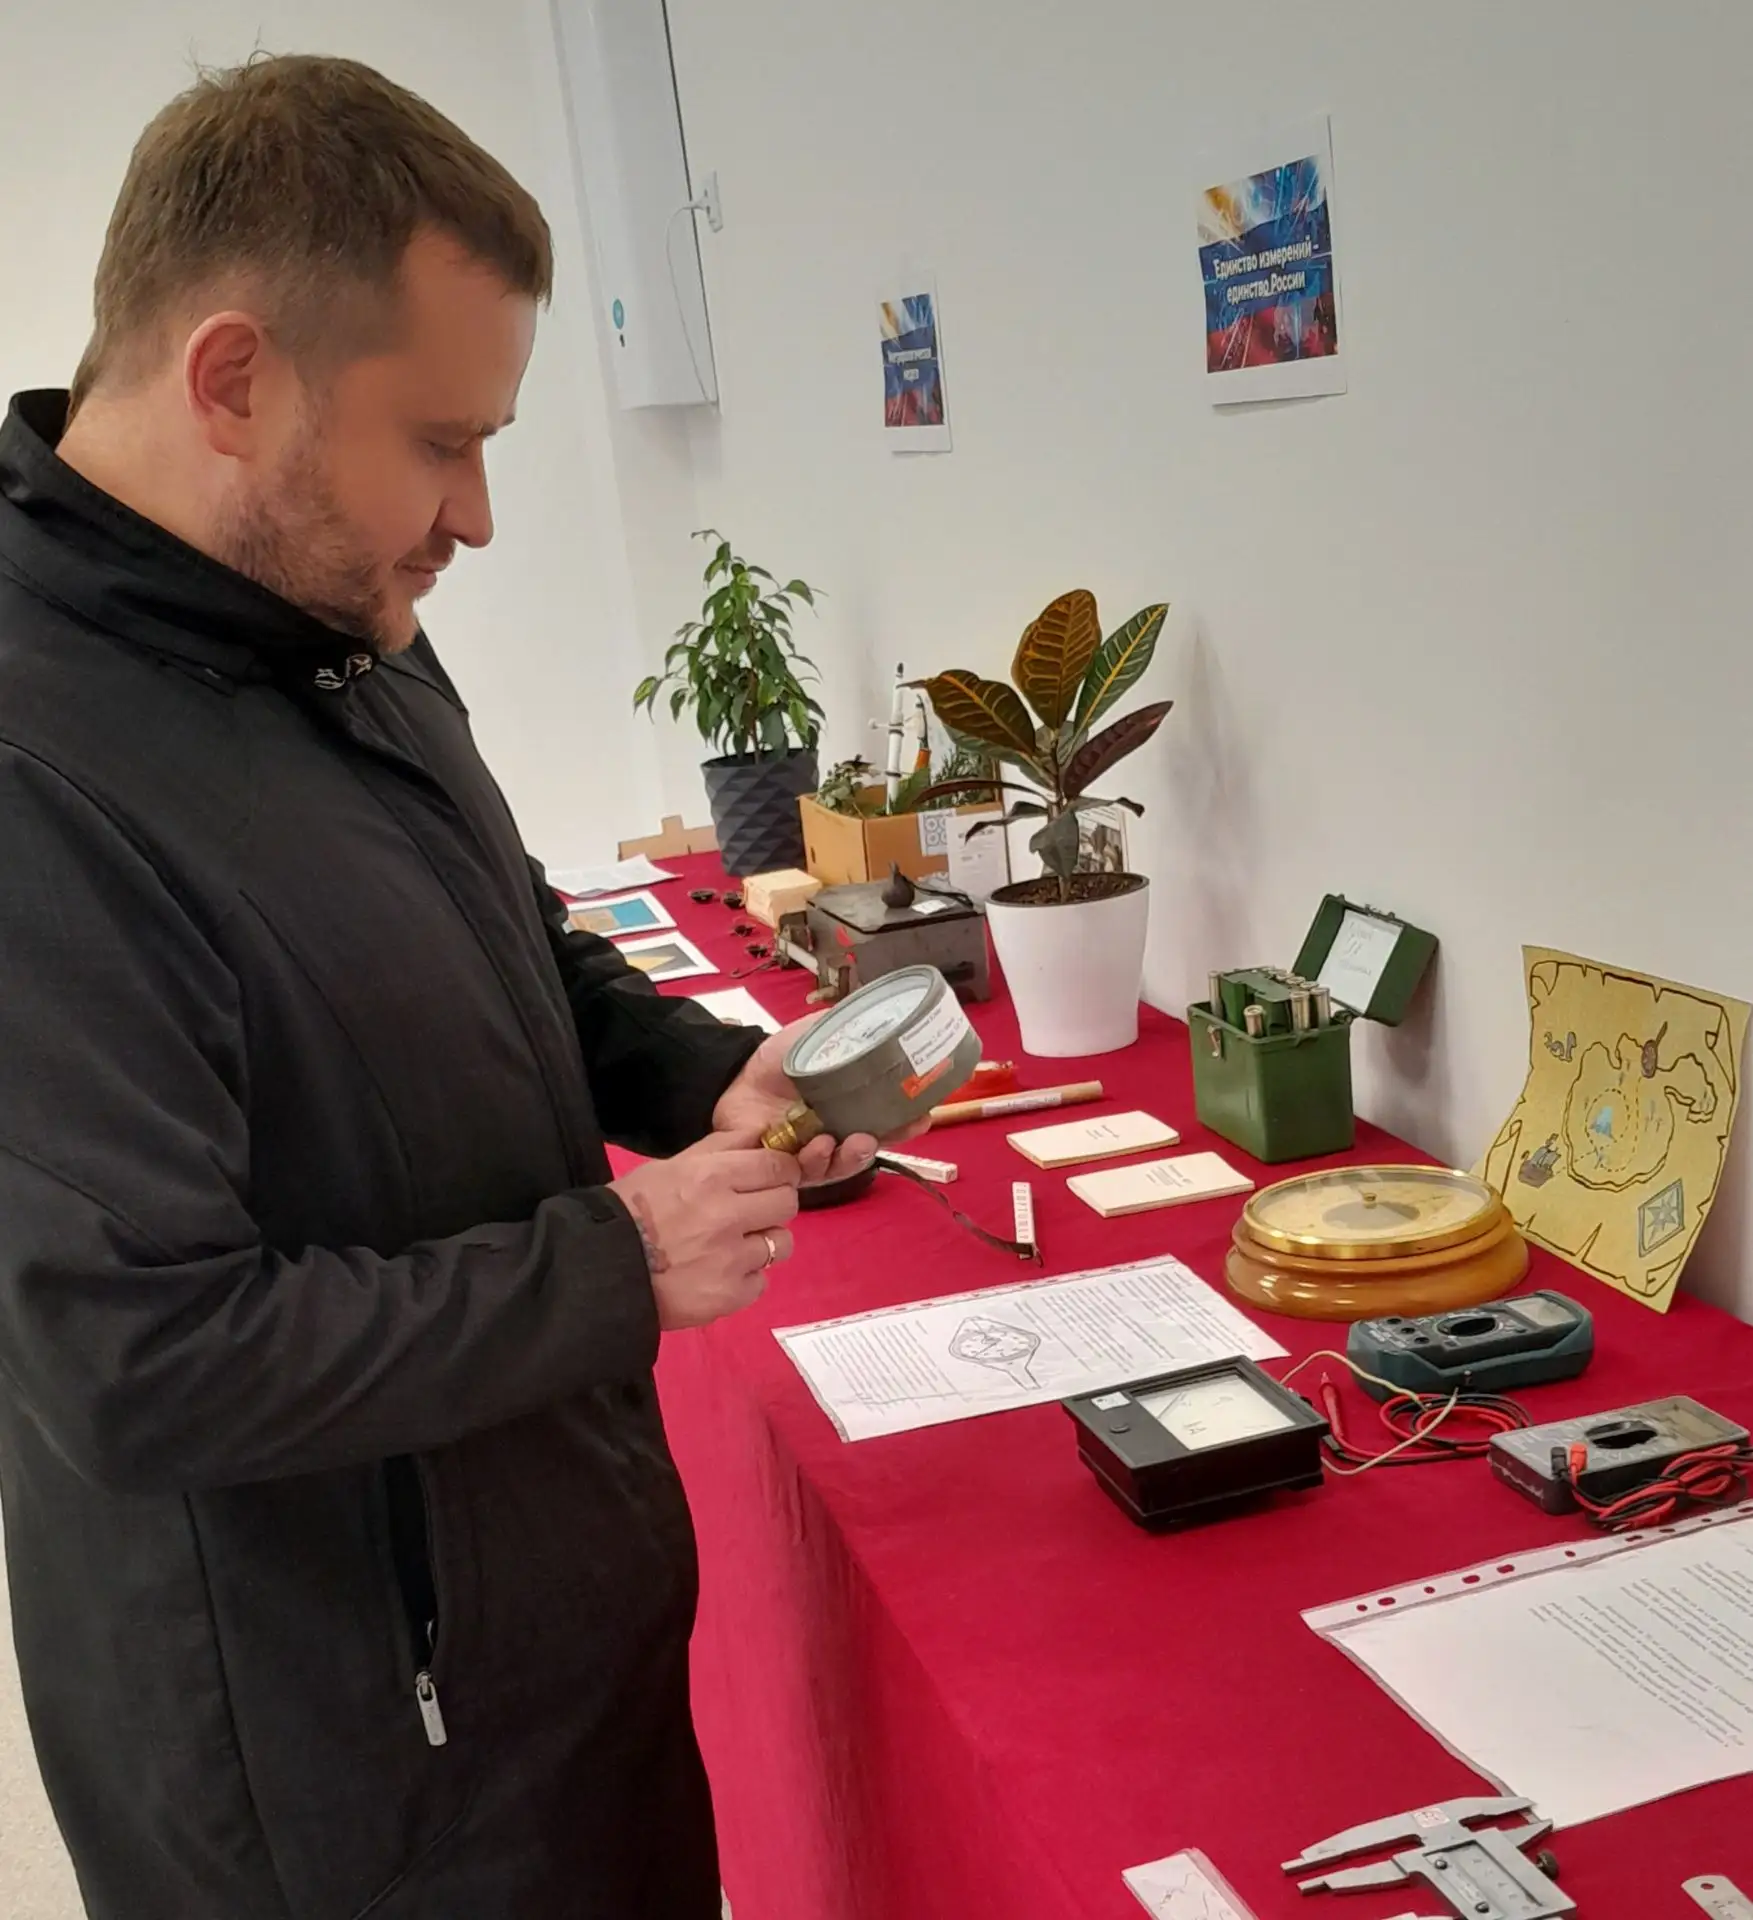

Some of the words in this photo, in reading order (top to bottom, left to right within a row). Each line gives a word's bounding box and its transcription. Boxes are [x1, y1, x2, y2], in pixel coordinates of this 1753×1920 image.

[1213, 254, 1258, 279] Единство
[1259, 235, 1312, 269] измерений
[1227, 280, 1270, 305] единство
[1271, 271, 1306, 295] России
